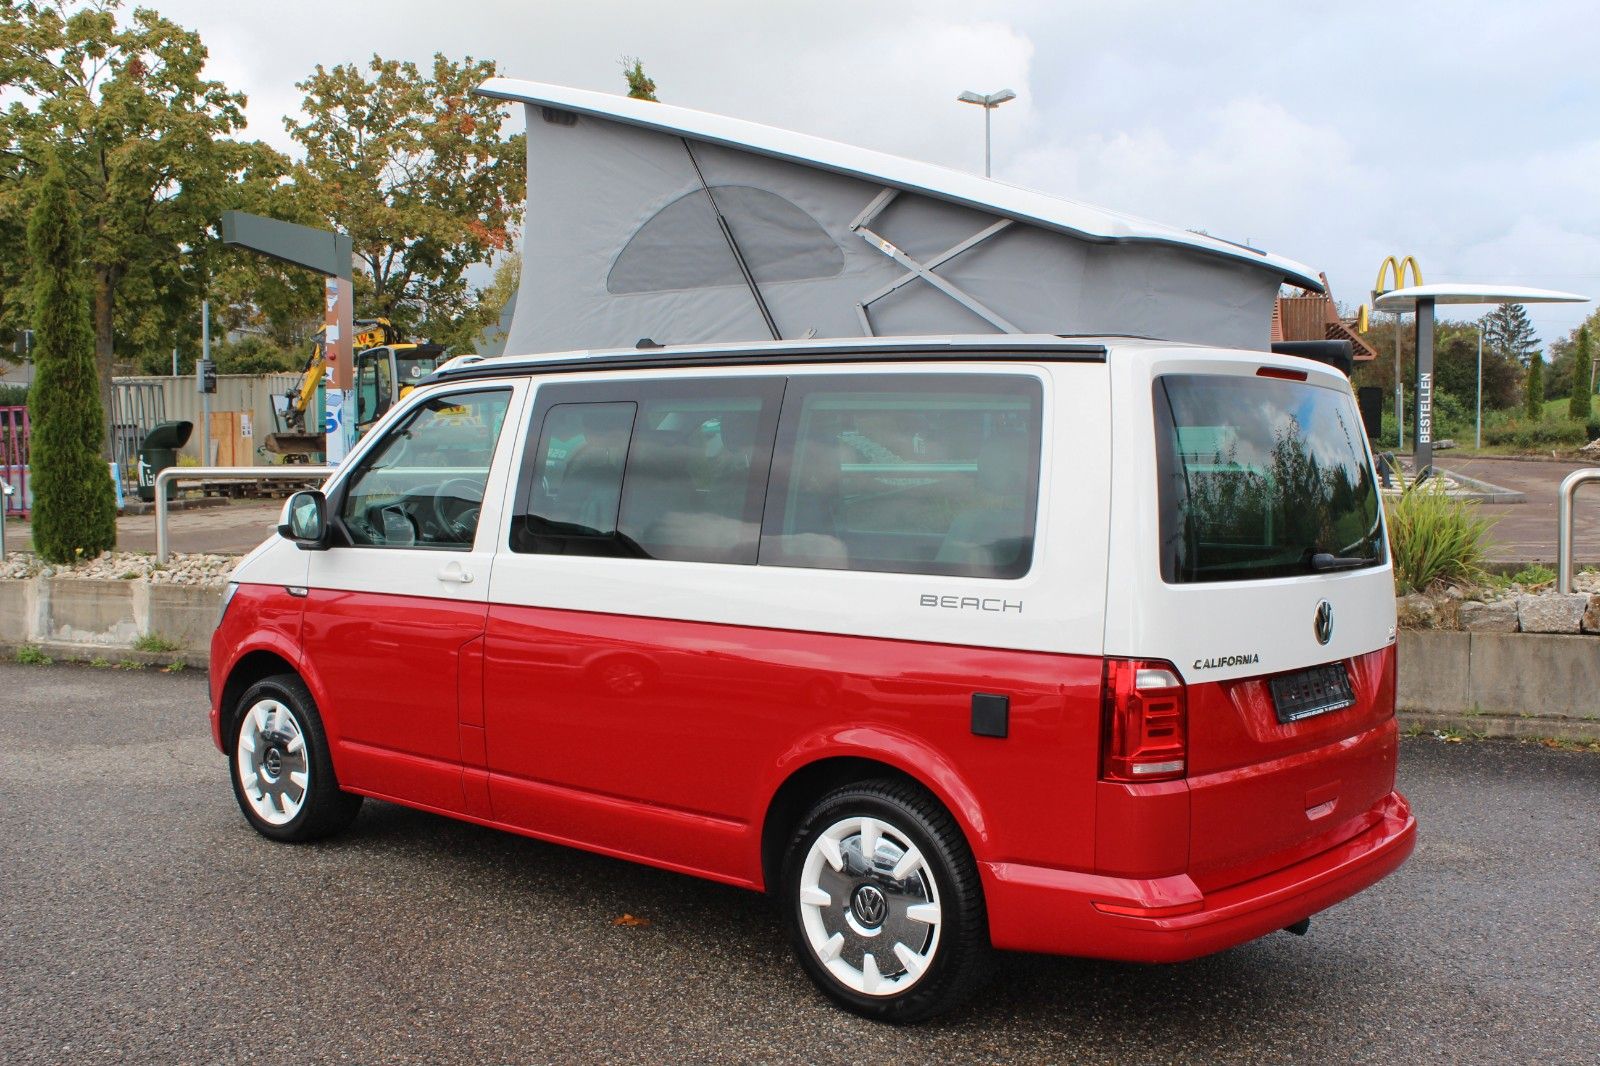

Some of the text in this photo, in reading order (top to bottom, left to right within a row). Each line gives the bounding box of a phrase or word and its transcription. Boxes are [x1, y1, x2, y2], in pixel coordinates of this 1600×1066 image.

[1420, 372, 1432, 443] BESTELLEN
[920, 594, 1023, 613] BEACH
[1193, 653, 1259, 670] CALIFORNIA
